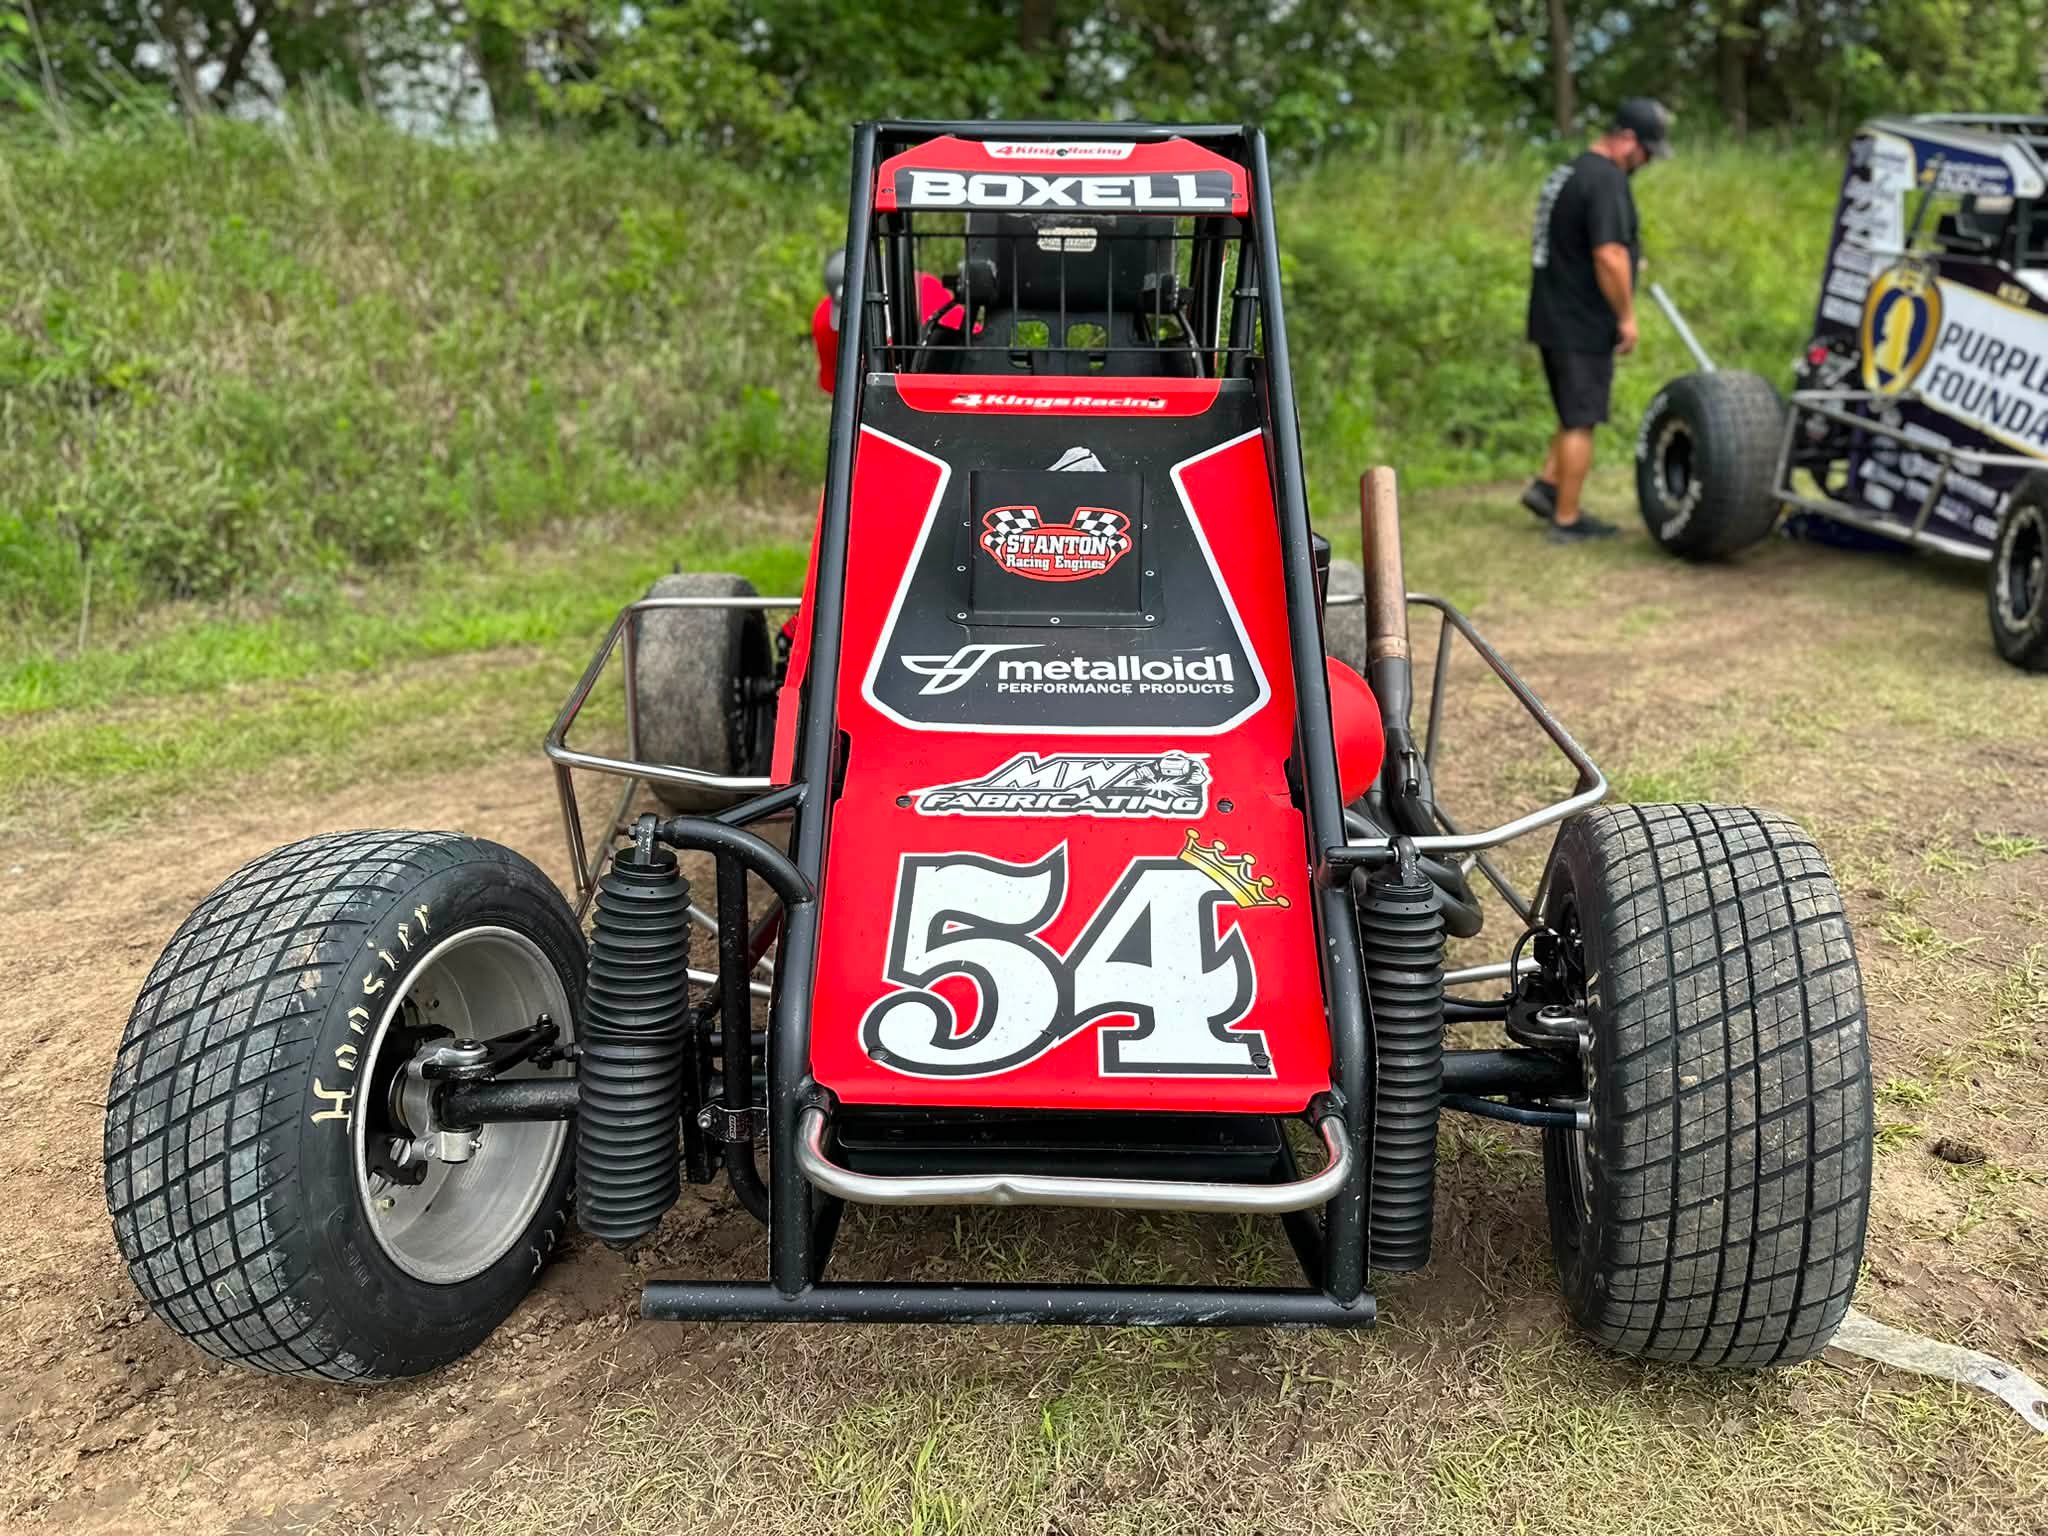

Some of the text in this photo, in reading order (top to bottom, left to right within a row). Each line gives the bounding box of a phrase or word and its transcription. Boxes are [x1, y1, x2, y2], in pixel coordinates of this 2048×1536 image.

[908, 171, 1226, 207] BOXELL
[1005, 533, 1108, 555] STANTON
[1005, 554, 1106, 572] Racing Engines
[998, 653, 1235, 681] metalloid1
[998, 683, 1235, 694] PERFORMANCE PRODUCTS
[975, 755, 1150, 791] MW
[920, 793, 1202, 813] FABRICATING
[858, 838, 1278, 1079] 54
